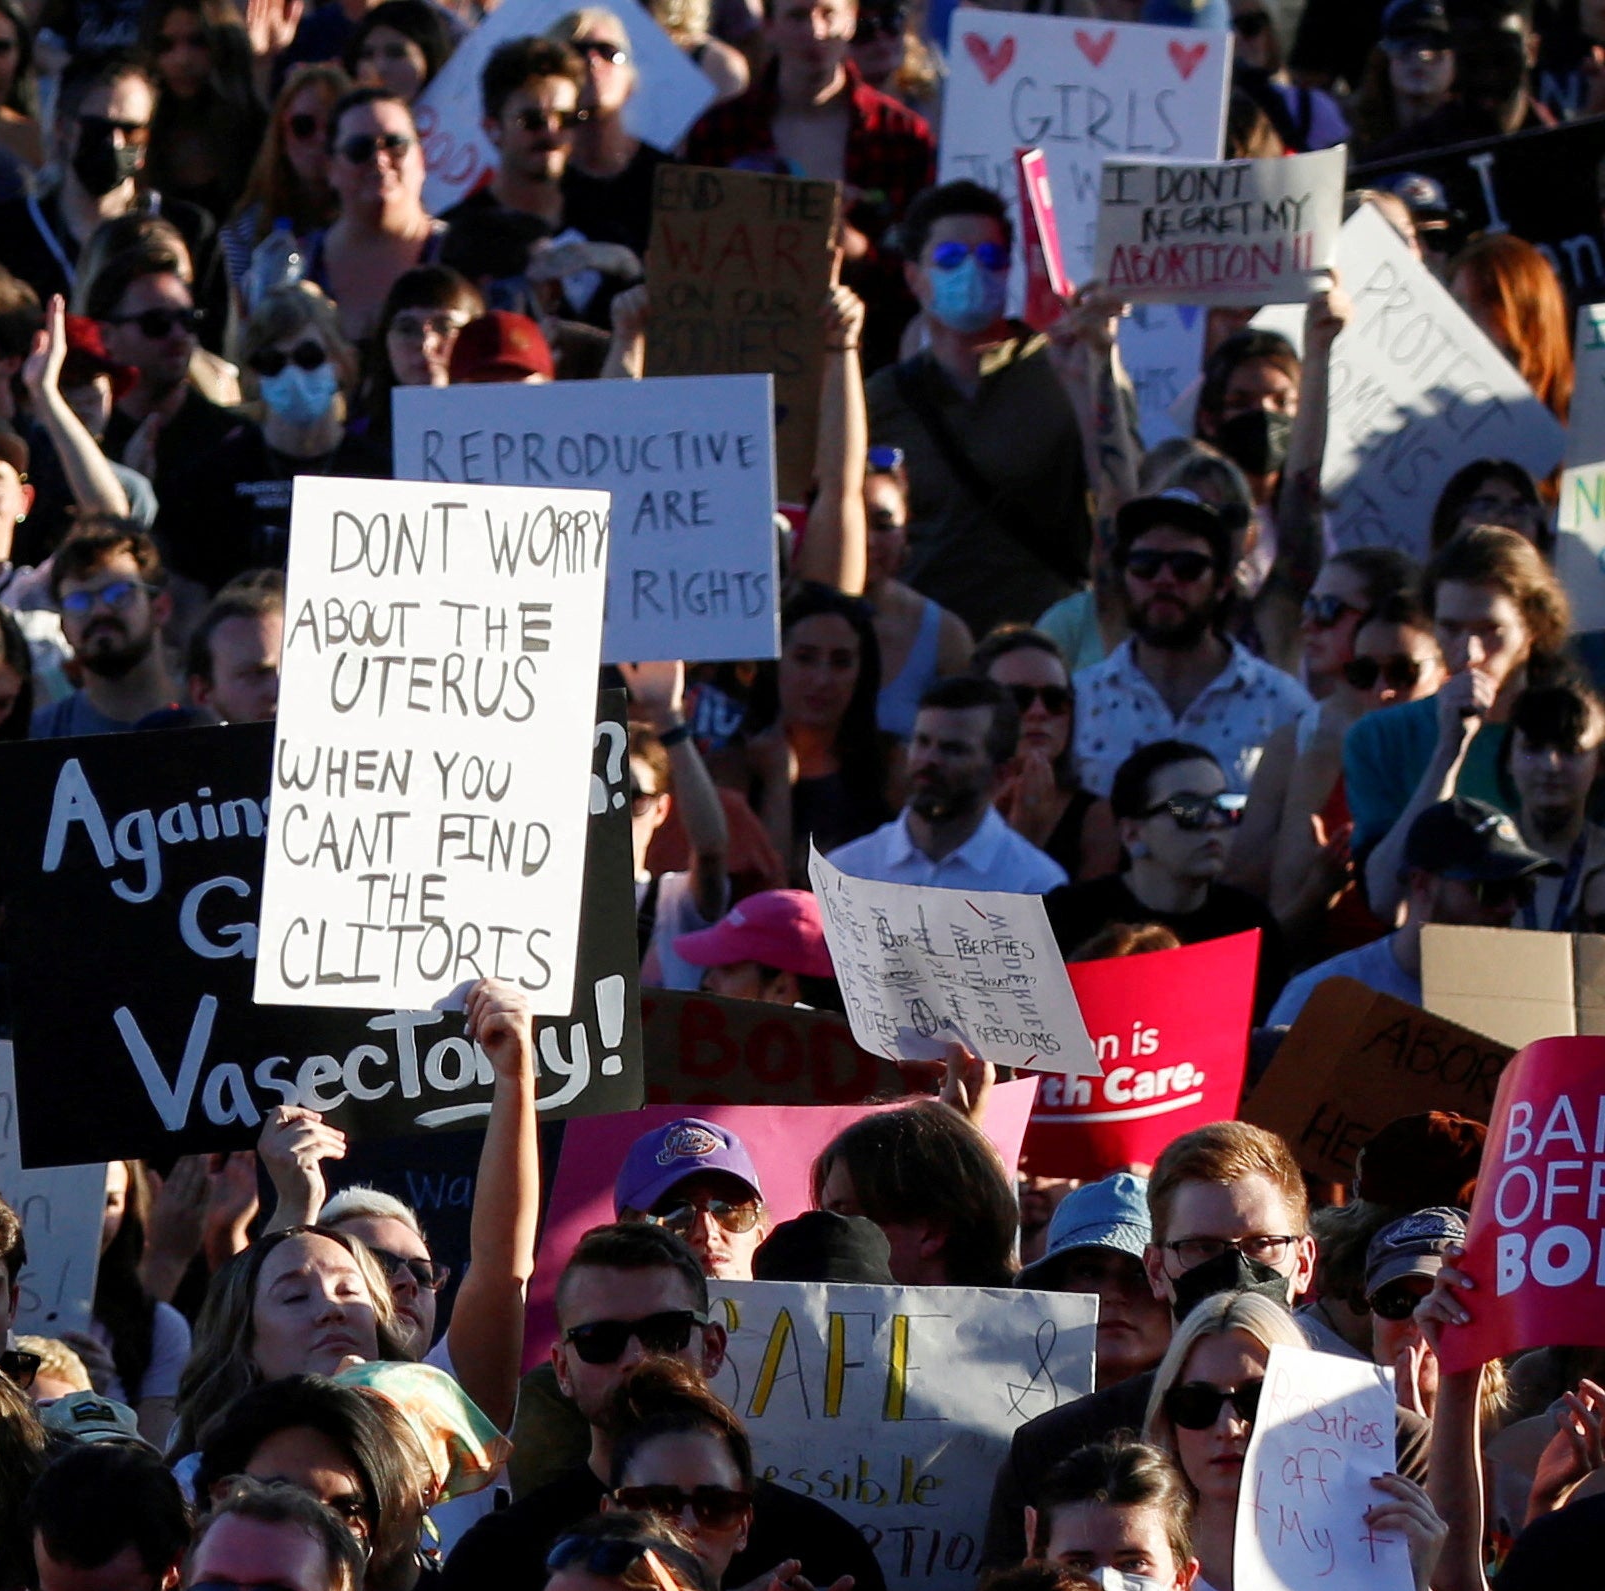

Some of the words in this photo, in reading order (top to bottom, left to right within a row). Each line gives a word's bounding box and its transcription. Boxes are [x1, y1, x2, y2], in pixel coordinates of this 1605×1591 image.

[1010, 77, 1181, 153] GIRLS
[1103, 166, 1137, 204] I
[1155, 164, 1252, 204] DONT
[1141, 200, 1258, 242] REGRET
[1262, 193, 1312, 234] MY
[660, 215, 807, 286] WAR
[1361, 261, 1513, 442] PROTECT
[423, 427, 757, 484] REPRODUCTIVE
[330, 502, 469, 579] DONT
[485, 504, 610, 578] WORRY
[631, 489, 714, 535] ARE
[287, 598, 421, 652] ABOUT
[439, 600, 553, 652] THE
[633, 568, 772, 621] RIGHTS
[329, 651, 538, 722] UTERUS
[277, 738, 412, 798] WHEN
[434, 750, 512, 803] YOU
[42, 756, 269, 902] Again
[281, 803, 411, 873] CANT
[436, 813, 551, 877] FIND
[357, 873, 447, 924] THE
[279, 917, 552, 991] CLITORIS
[1131, 1021, 1160, 1057] is
[1362, 1016, 1505, 1094] ABOR
[1103, 1061, 1205, 1104] Care.
[1497, 1225, 1605, 1297] BO
[1266, 1368, 1385, 1448] Rosaries
[762, 1453, 944, 1508] essible
[1279, 1505, 1335, 1576] My
